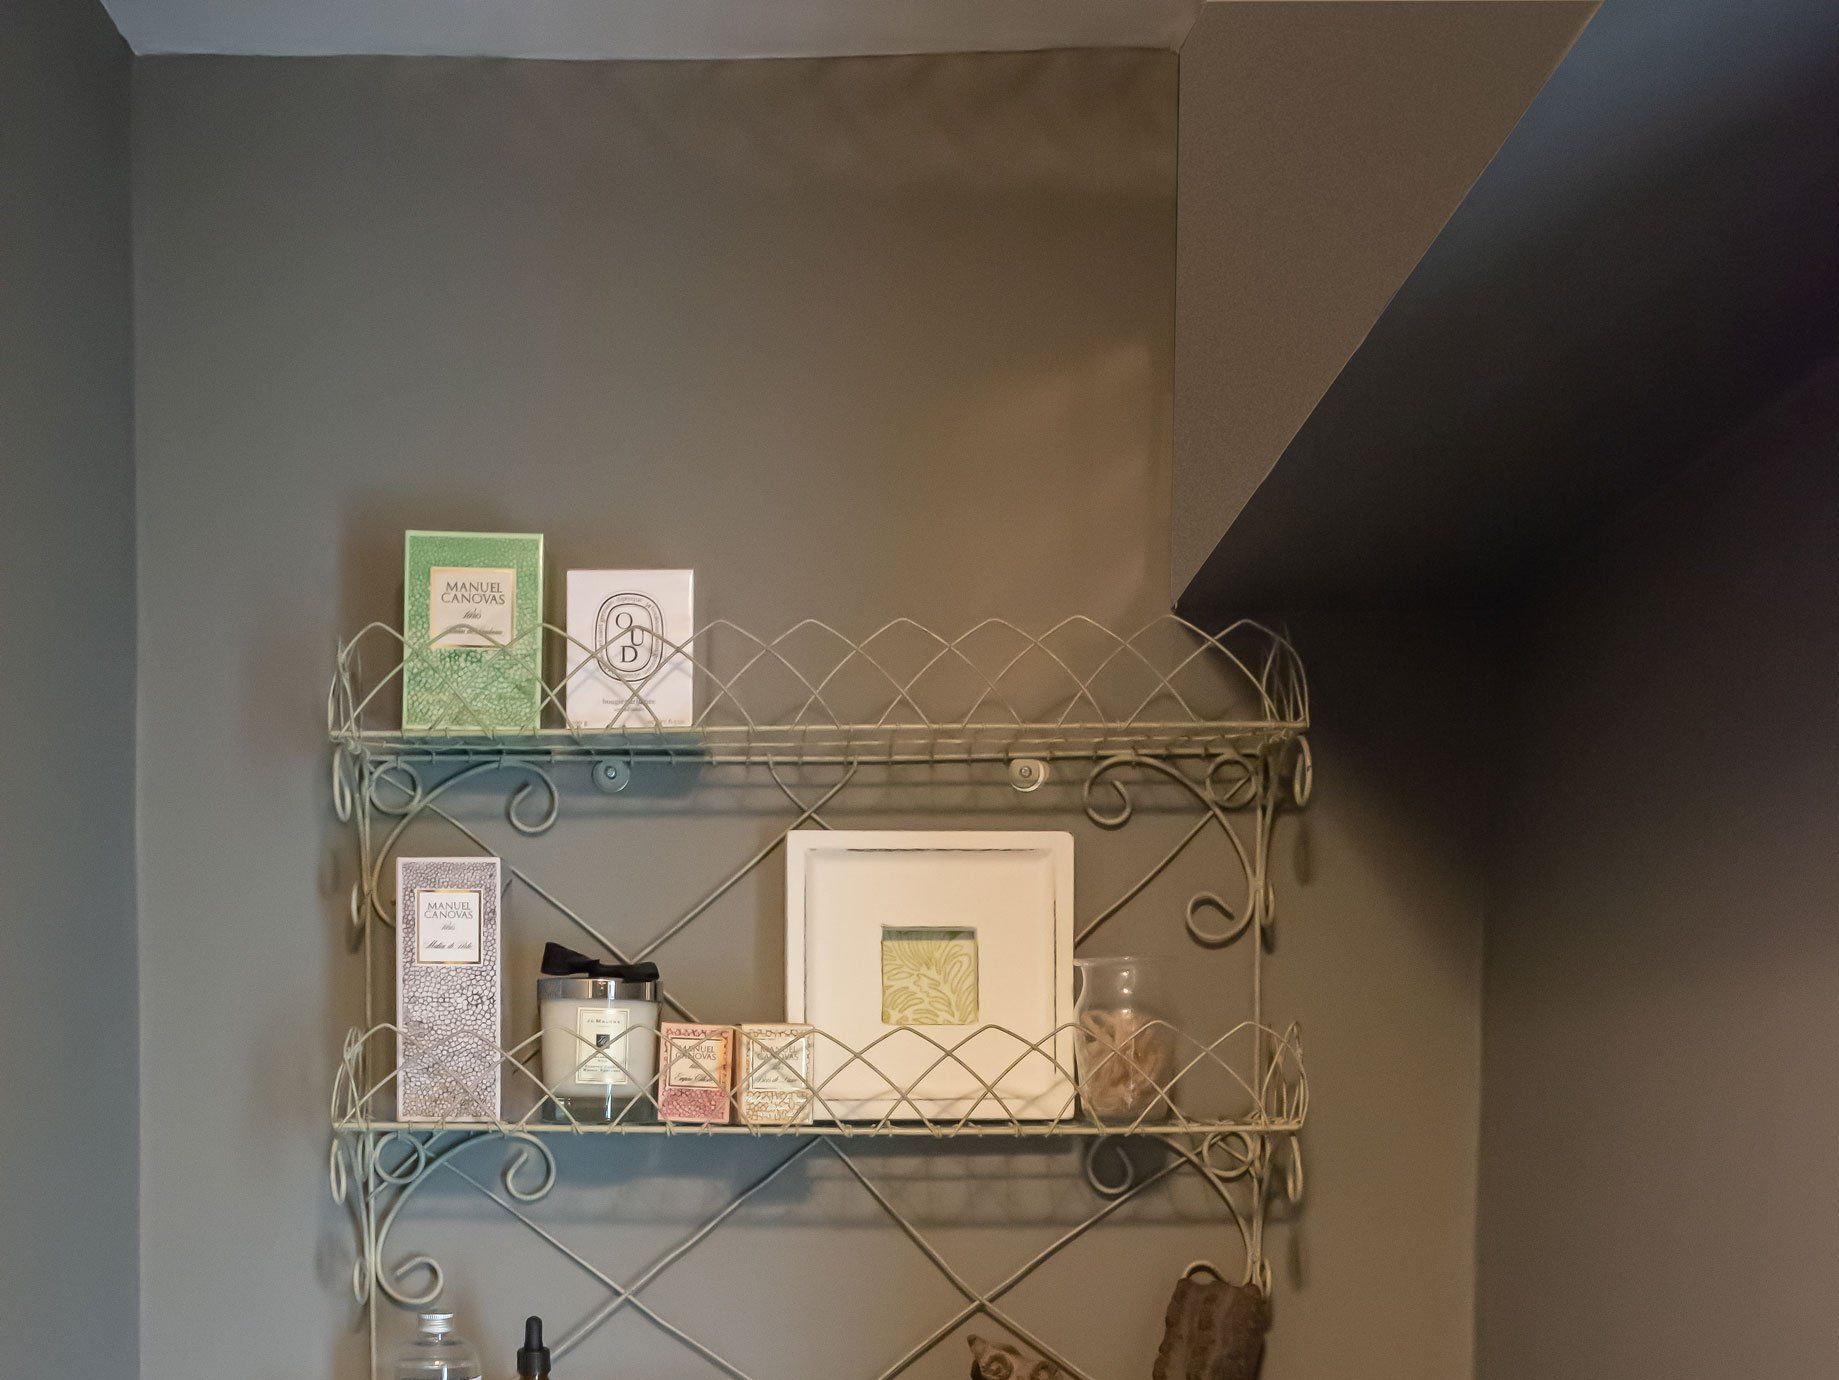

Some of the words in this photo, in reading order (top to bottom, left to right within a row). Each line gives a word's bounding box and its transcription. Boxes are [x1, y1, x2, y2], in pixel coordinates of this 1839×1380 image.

[446, 581, 503, 593] MANUEL
[441, 593, 506, 605] CANOVAS
[427, 901, 471, 910] MANUEL
[424, 910, 474, 919] CANOVAS
